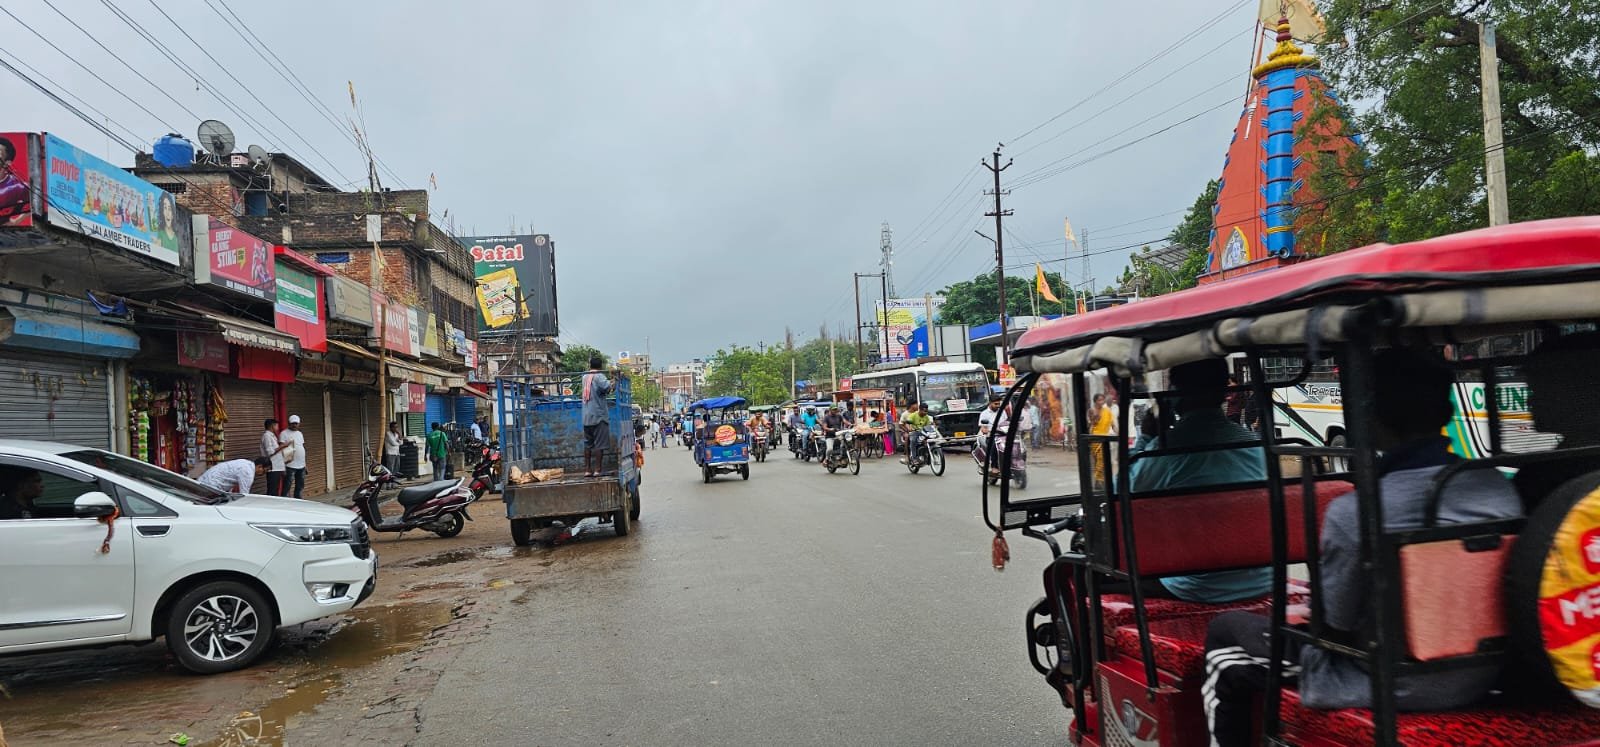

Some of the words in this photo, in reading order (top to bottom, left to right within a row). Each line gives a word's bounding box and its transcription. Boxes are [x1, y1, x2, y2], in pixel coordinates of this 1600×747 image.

[103, 227, 122, 243] AMBE
[123, 235, 151, 253] TRADERS
[470, 244, 524, 261] Safal
